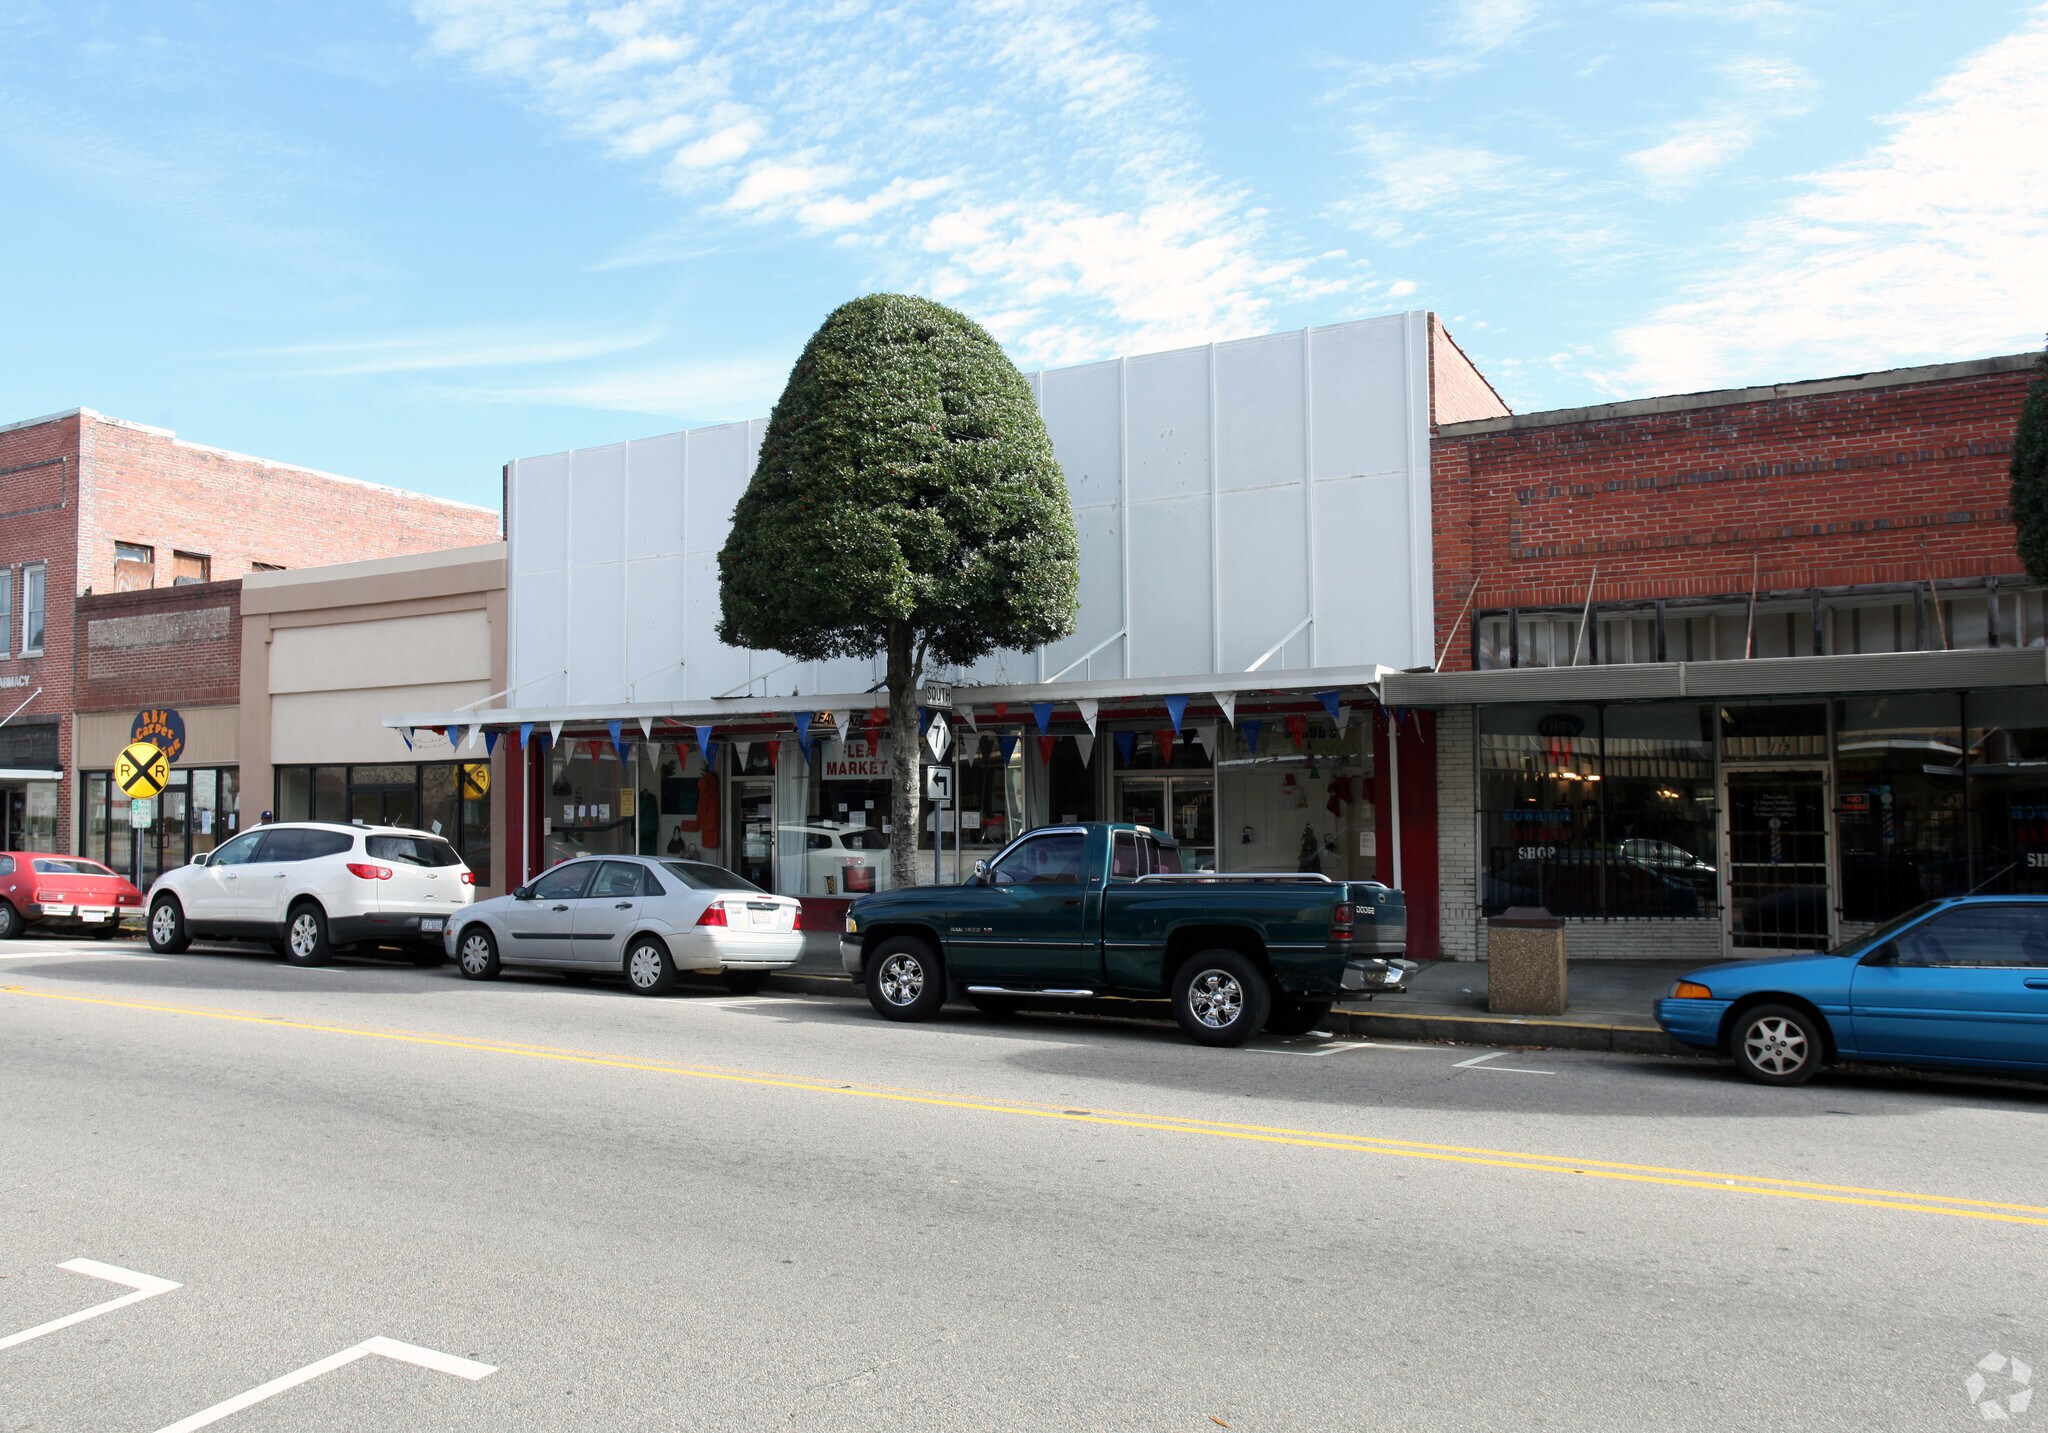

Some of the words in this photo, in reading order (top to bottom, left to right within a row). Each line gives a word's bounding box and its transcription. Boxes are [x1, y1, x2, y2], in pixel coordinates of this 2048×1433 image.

[927, 686, 951, 702] SOUTH
[142, 709, 168, 725] RBM
[135, 723, 174, 741] Carpet
[1542, 719, 1577, 734] OPEN
[932, 725, 946, 750] 71
[120, 764, 131, 777] R
[155, 764, 165, 777] R
[826, 761, 888, 775] MARKET
[1518, 847, 1556, 860] SHOP
[1355, 905, 1375, 915] DODGE
